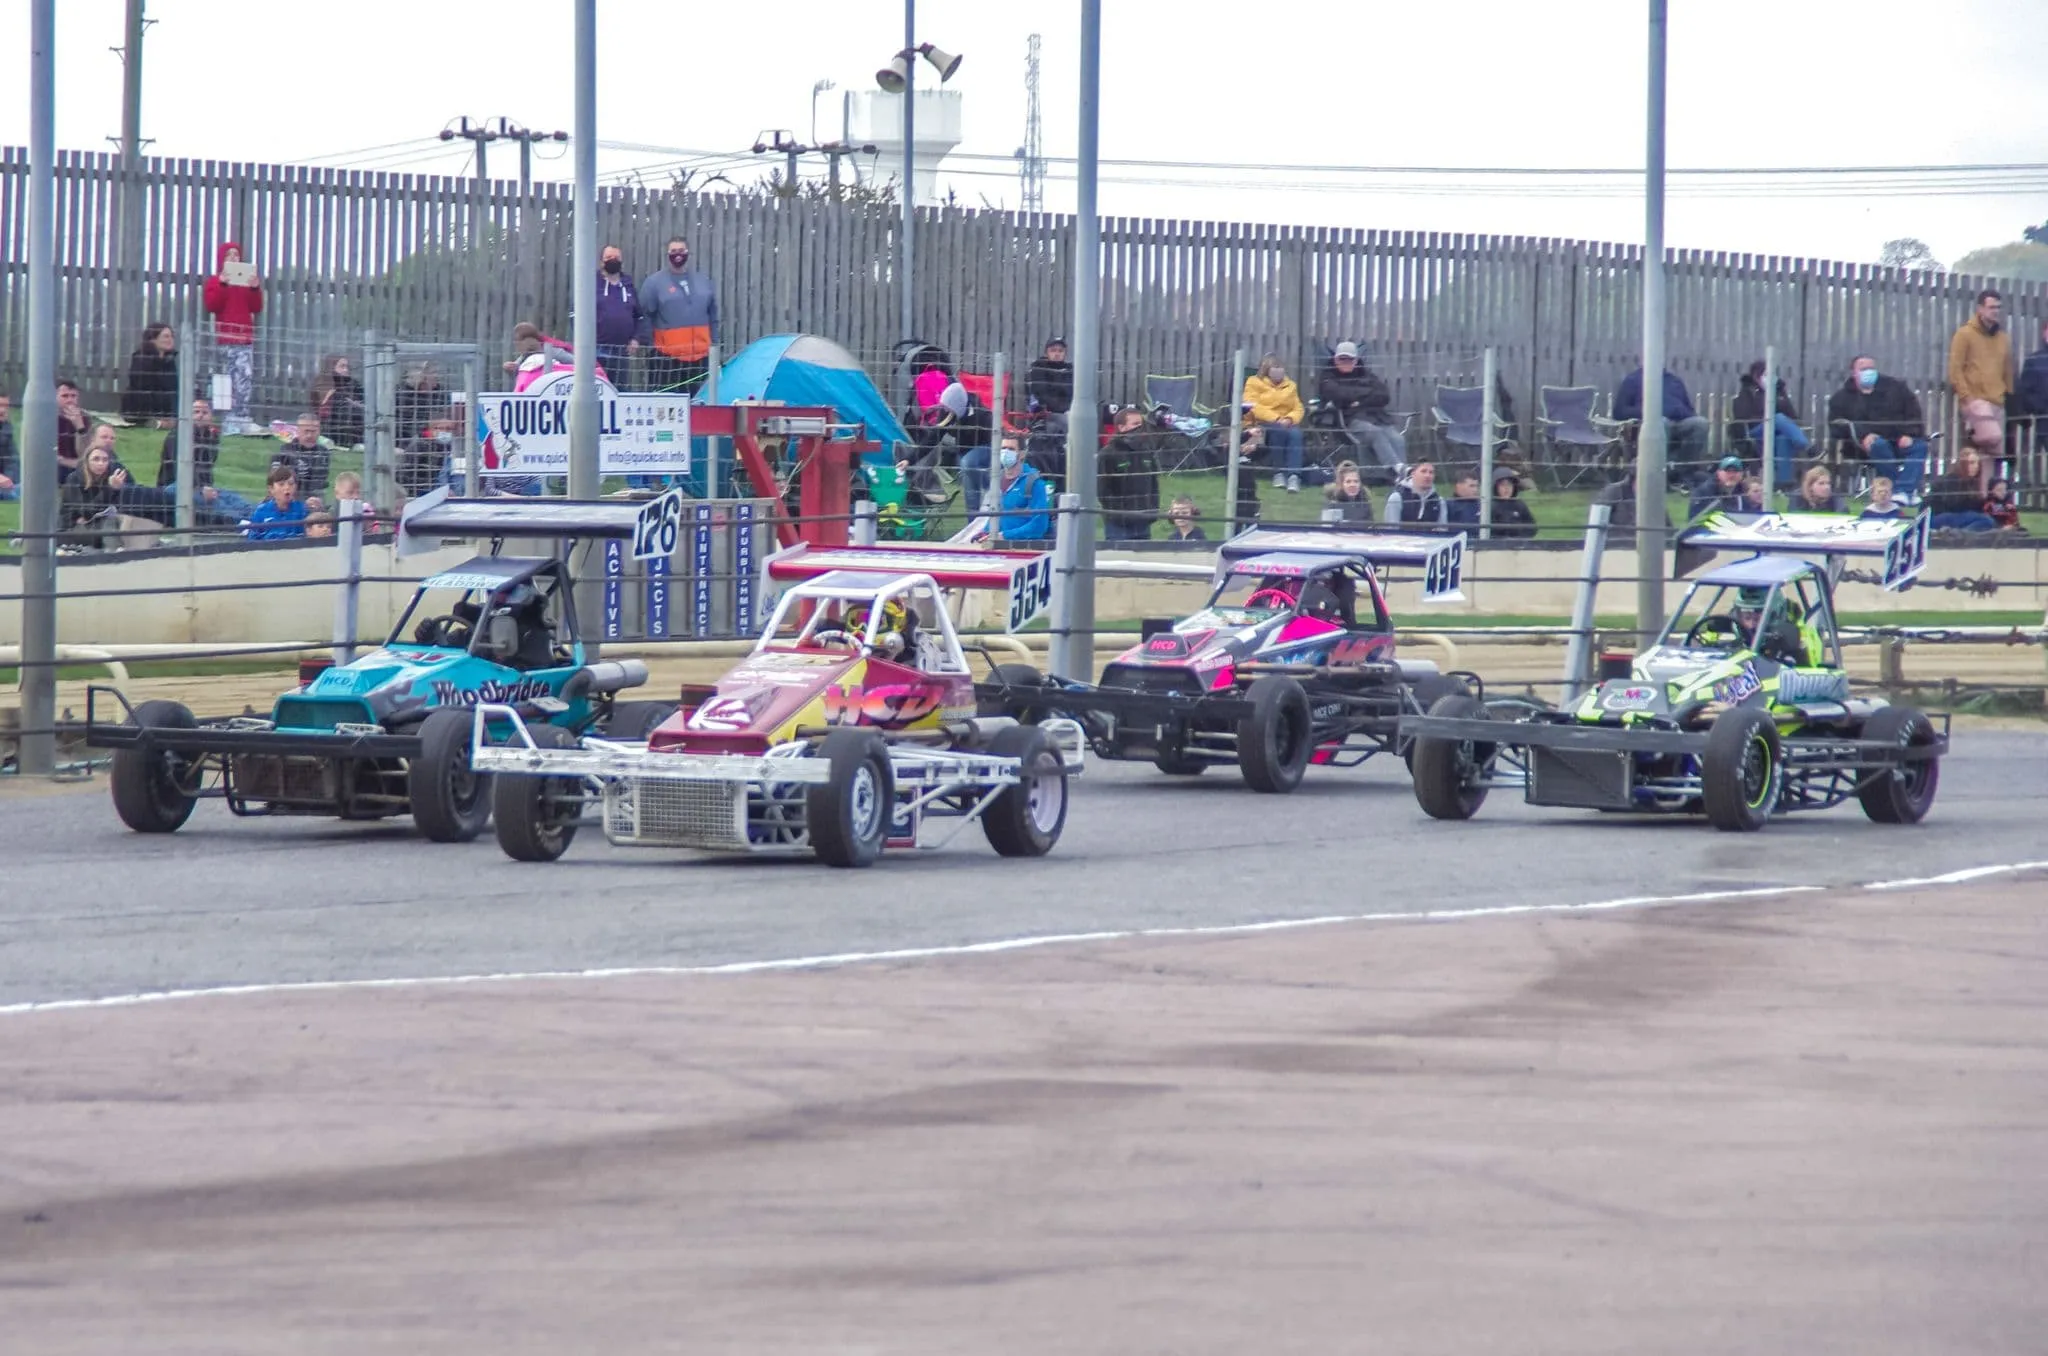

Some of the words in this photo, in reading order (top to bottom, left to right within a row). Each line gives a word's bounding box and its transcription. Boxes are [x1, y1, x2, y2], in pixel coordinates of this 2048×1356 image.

[500, 400, 622, 438] QUICKLL
[634, 493, 680, 556] 176
[1885, 511, 1927, 585] 251
[1011, 556, 1051, 629] 354
[1427, 541, 1462, 595] 492
[1151, 639, 1177, 651] HCD
[430, 678, 552, 705] Woodbridge
